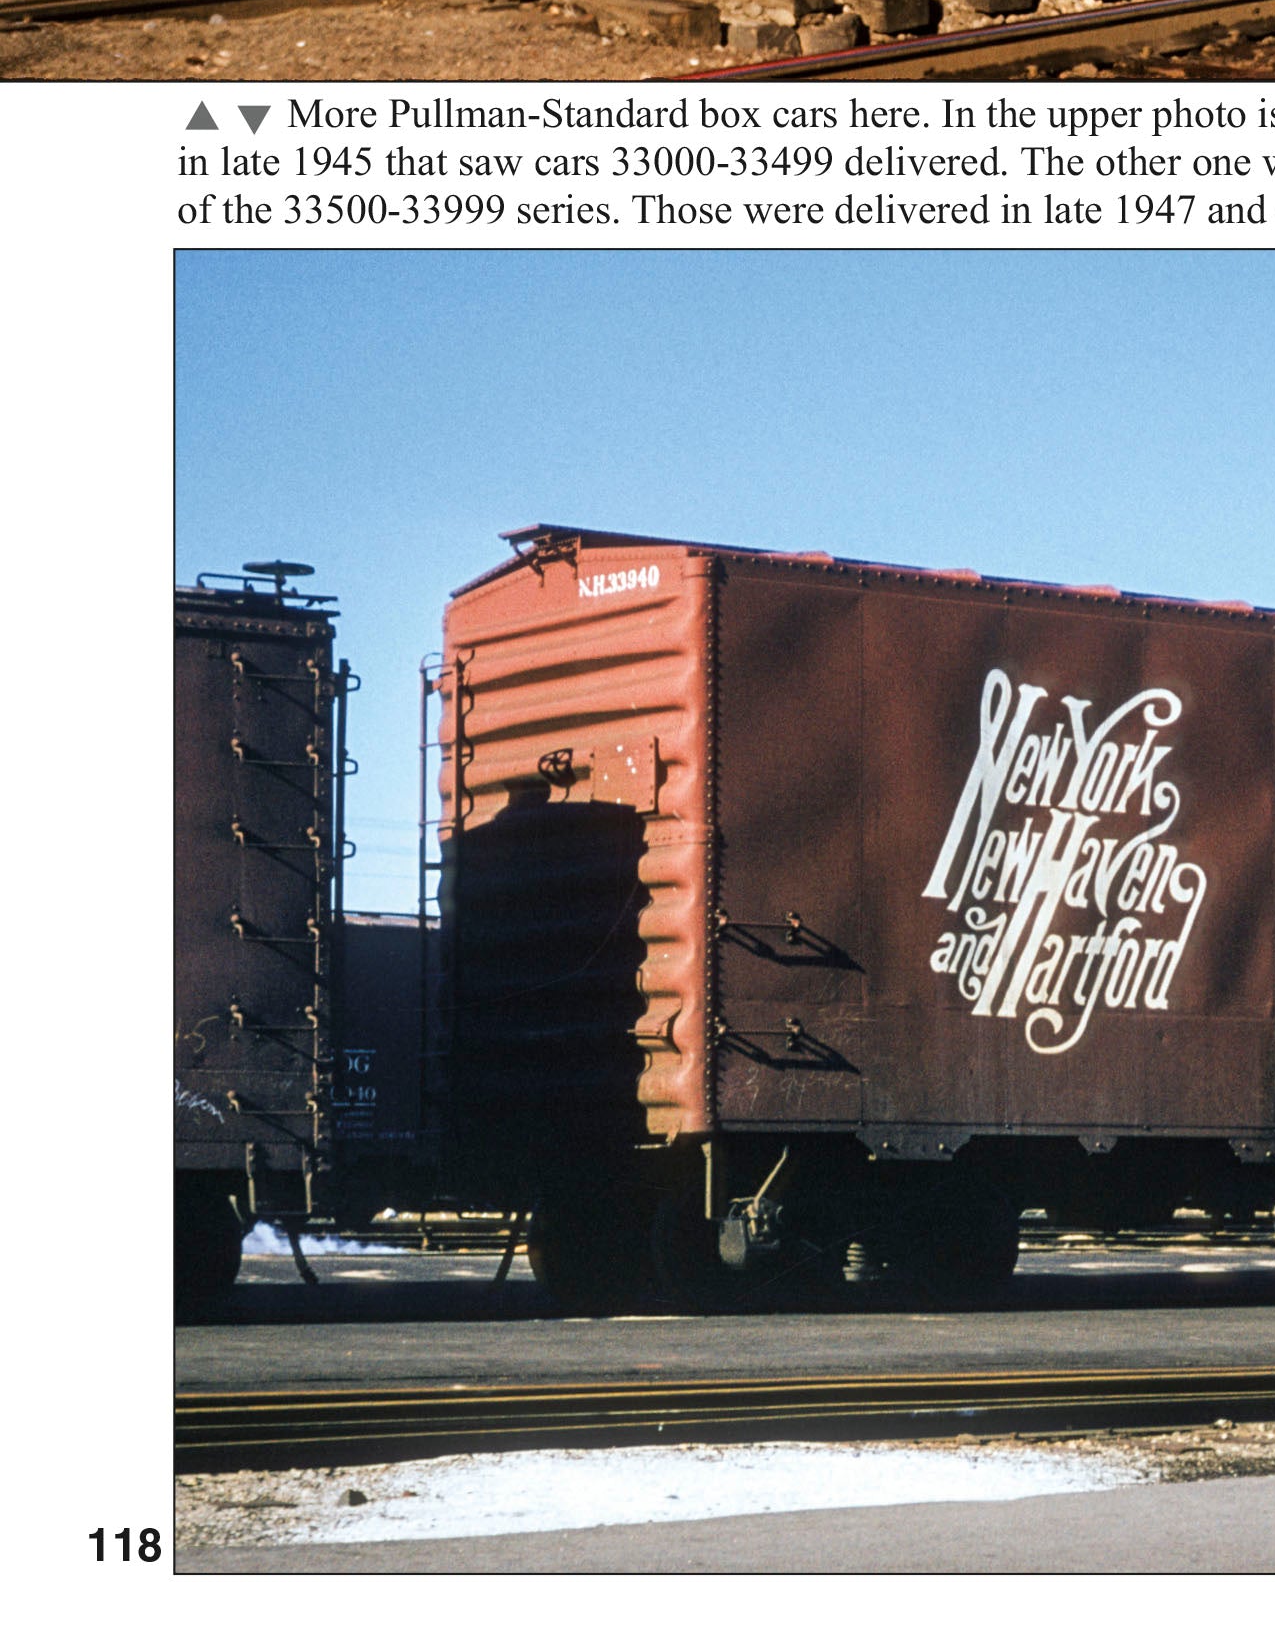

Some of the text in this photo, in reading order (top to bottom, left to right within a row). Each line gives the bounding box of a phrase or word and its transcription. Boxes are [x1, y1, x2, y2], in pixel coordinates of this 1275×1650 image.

[1020, 781, 1181, 917] Haven
[930, 863, 1207, 1054] and Hartford
